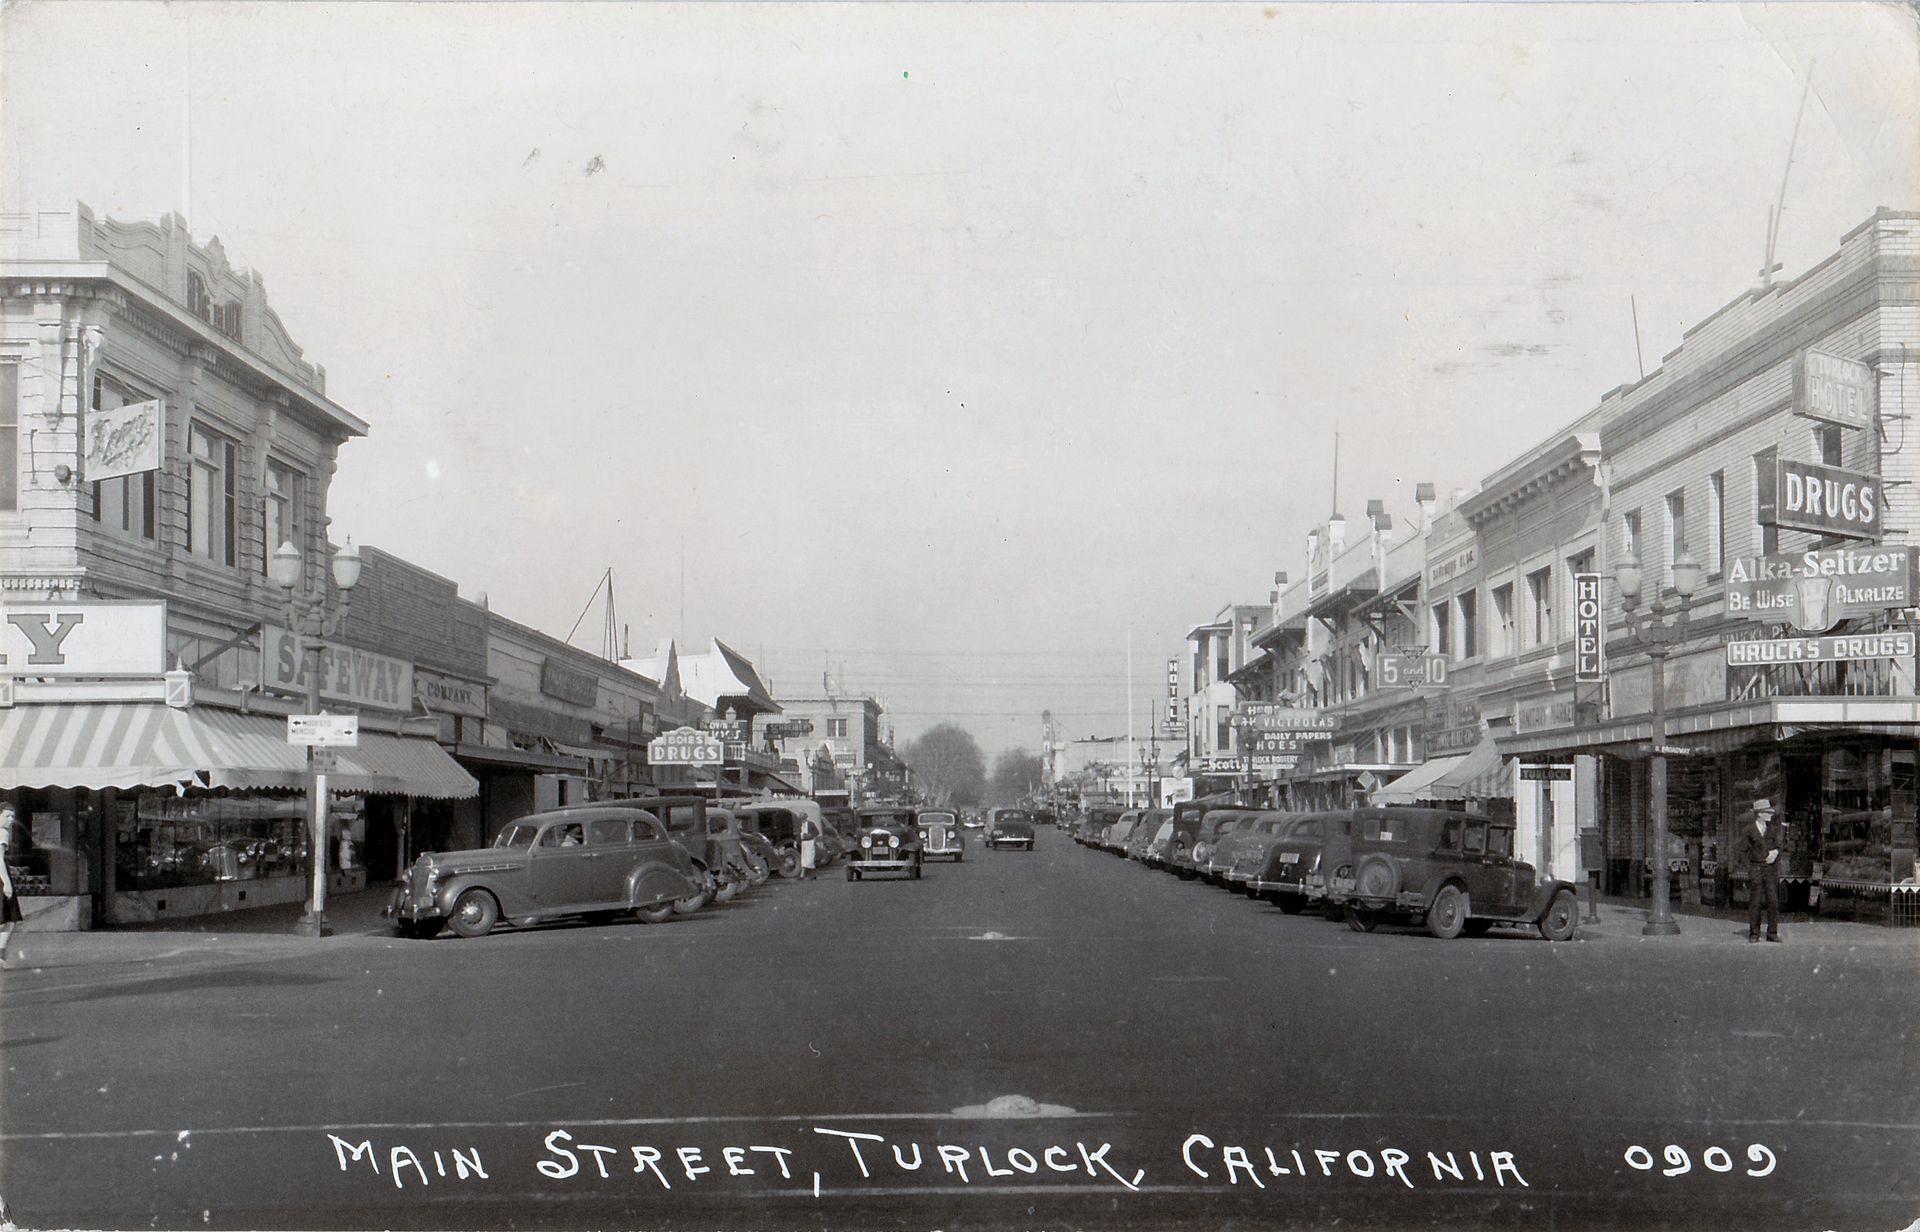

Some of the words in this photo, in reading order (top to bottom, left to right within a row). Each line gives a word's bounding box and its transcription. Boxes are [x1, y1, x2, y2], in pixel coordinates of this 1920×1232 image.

[1811, 376, 1868, 420] HOTEL
[1786, 472, 1876, 524] DRUGS
[1728, 550, 1906, 584] Alka-Seltzer
[1729, 591, 1750, 611] BE
[1757, 590, 1794, 609] WISE
[1836, 585, 1905, 604] ALKALIZE
[0, 613, 84, 665] Y
[1579, 581, 1598, 673] HOTEL
[1834, 637, 1909, 658] DRUGS
[1384, 658, 1398, 683] 5
[1403, 665, 1424, 675] and
[1426, 658, 1446, 683] 10
[427, 681, 472, 704] COMPANY
[1169, 662, 1178, 717] HOTEL
[1263, 717, 1335, 728] VICTROLAS
[668, 735, 704, 745] BOIES
[1245, 740, 1297, 751] HOES
[1264, 732, 1292, 741] DAILY
[1296, 732, 1333, 740] PAPERS
[654, 745, 718, 760] DRUGS
[1523, 769, 1569, 779] TURLOCK
